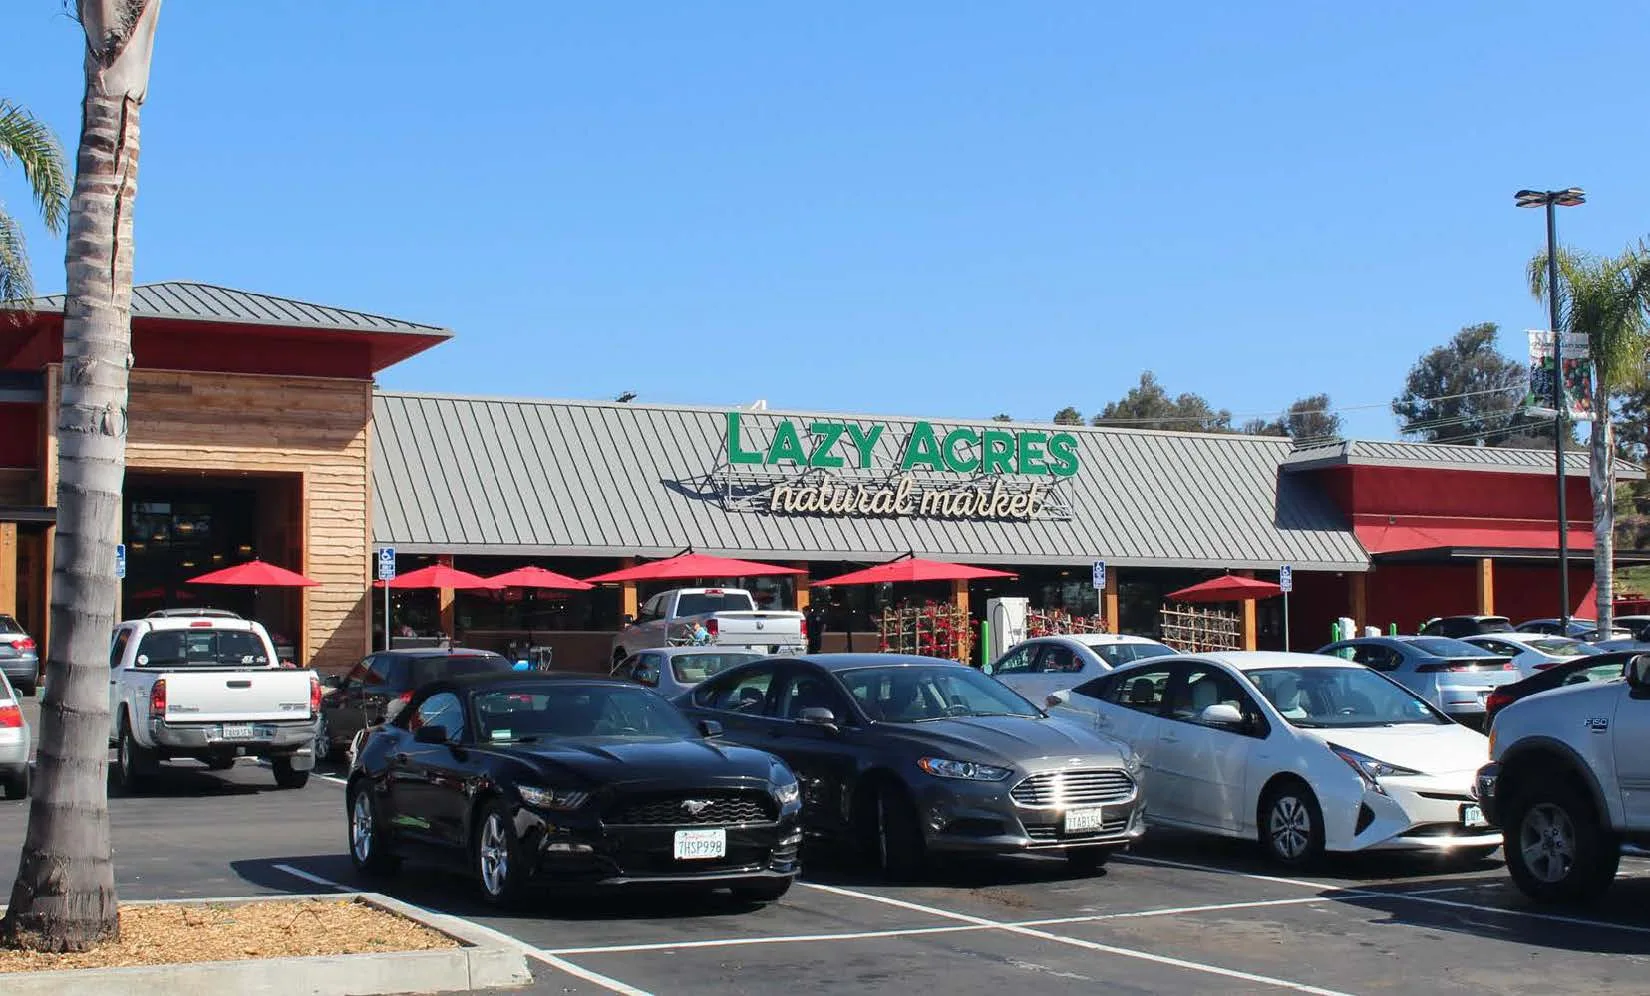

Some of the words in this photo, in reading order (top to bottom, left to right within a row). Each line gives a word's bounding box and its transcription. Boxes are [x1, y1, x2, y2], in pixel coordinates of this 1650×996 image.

[726, 411, 885, 468] LAZY
[900, 420, 1080, 477] ACRES
[769, 475, 913, 514] natural
[918, 478, 1045, 517] market
